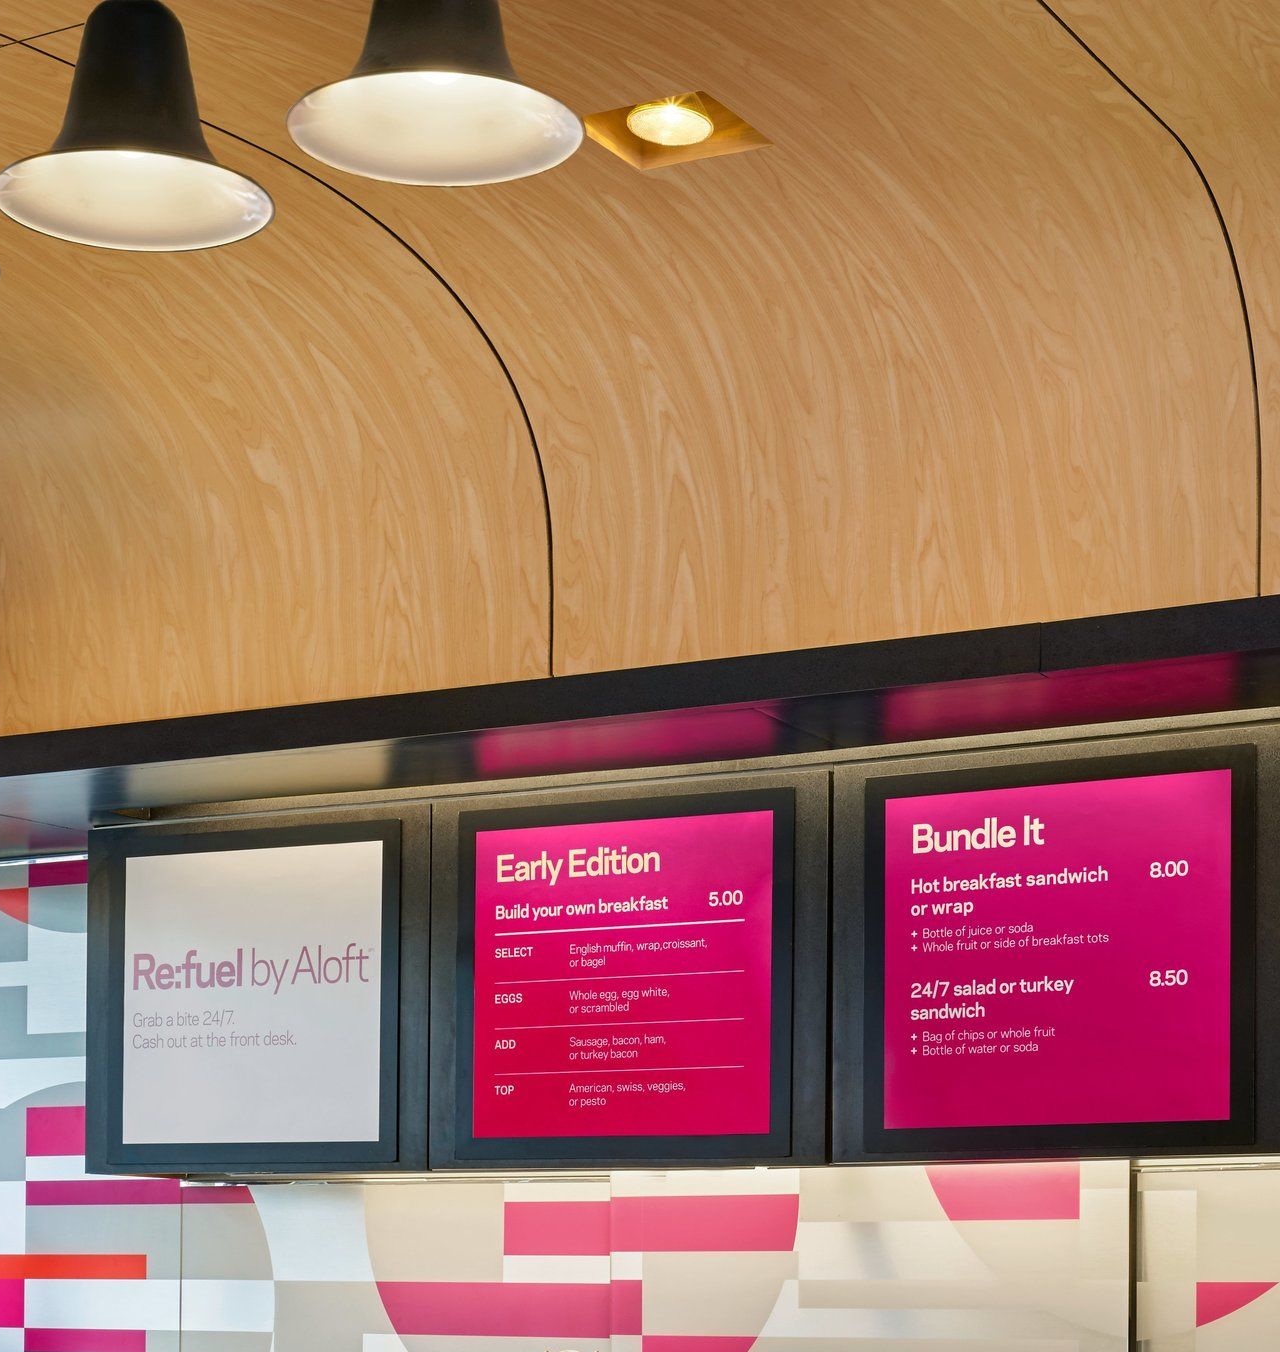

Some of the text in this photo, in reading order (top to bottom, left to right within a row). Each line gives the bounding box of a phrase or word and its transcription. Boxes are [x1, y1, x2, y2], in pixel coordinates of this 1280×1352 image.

[913, 815, 1044, 854] Bundle It
[497, 846, 660, 886] Early Edition
[1150, 860, 1188, 878] 8.00
[912, 866, 1108, 894] Hot breakfast sandwich
[709, 890, 743, 907] 5.00
[496, 896, 668, 921] Build your own breakfast
[911, 902, 973, 916] or wrap
[923, 922, 1033, 938] Bottle of juice or soda
[570, 943, 602, 956] English
[603, 941, 633, 952] muffin,
[923, 934, 1109, 952] Whole fruit or side of breakfast tots
[495, 947, 533, 958] SELECT
[133, 943, 369, 995] Re:fuel by Aloft
[1150, 969, 1188, 987] 8.50
[570, 987, 669, 1001] Whole egg, egg white,
[911, 976, 1074, 998] 24/7 salad or turkey
[495, 993, 522, 1004] EGGS
[133, 1009, 234, 1027] Grab a bite 24/7.
[911, 1002, 985, 1020] sandwich
[133, 1030, 296, 1049] Cash out at the front desk.
[495, 1040, 516, 1049] ADD
[570, 1034, 665, 1048] Sausage, bacon, ham,
[495, 1085, 514, 1095] TOP
[569, 1082, 685, 1093] American, swiss, veggies,
